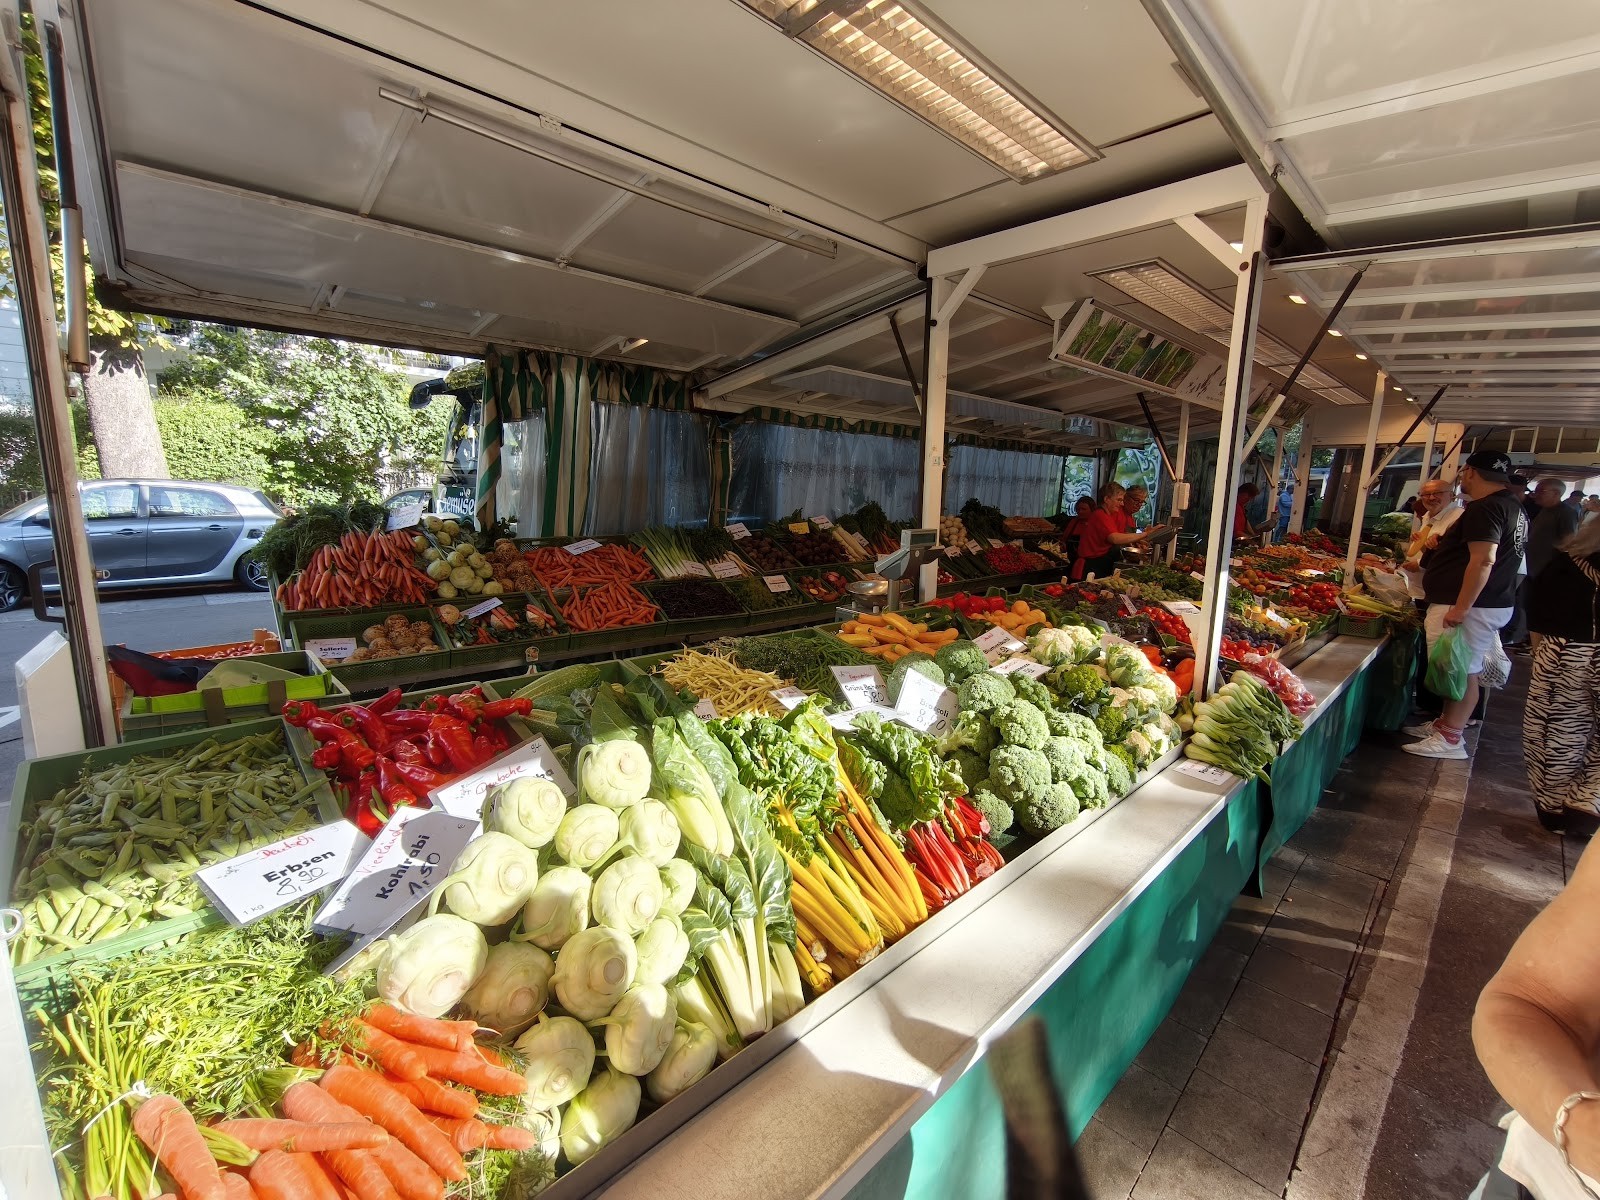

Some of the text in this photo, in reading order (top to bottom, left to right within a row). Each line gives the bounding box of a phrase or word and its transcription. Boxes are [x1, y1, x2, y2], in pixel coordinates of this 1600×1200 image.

[262, 850, 337, 883] Erbsen
[375, 834, 431, 900] Kohlrabi
[250, 904, 265, 914] kg
